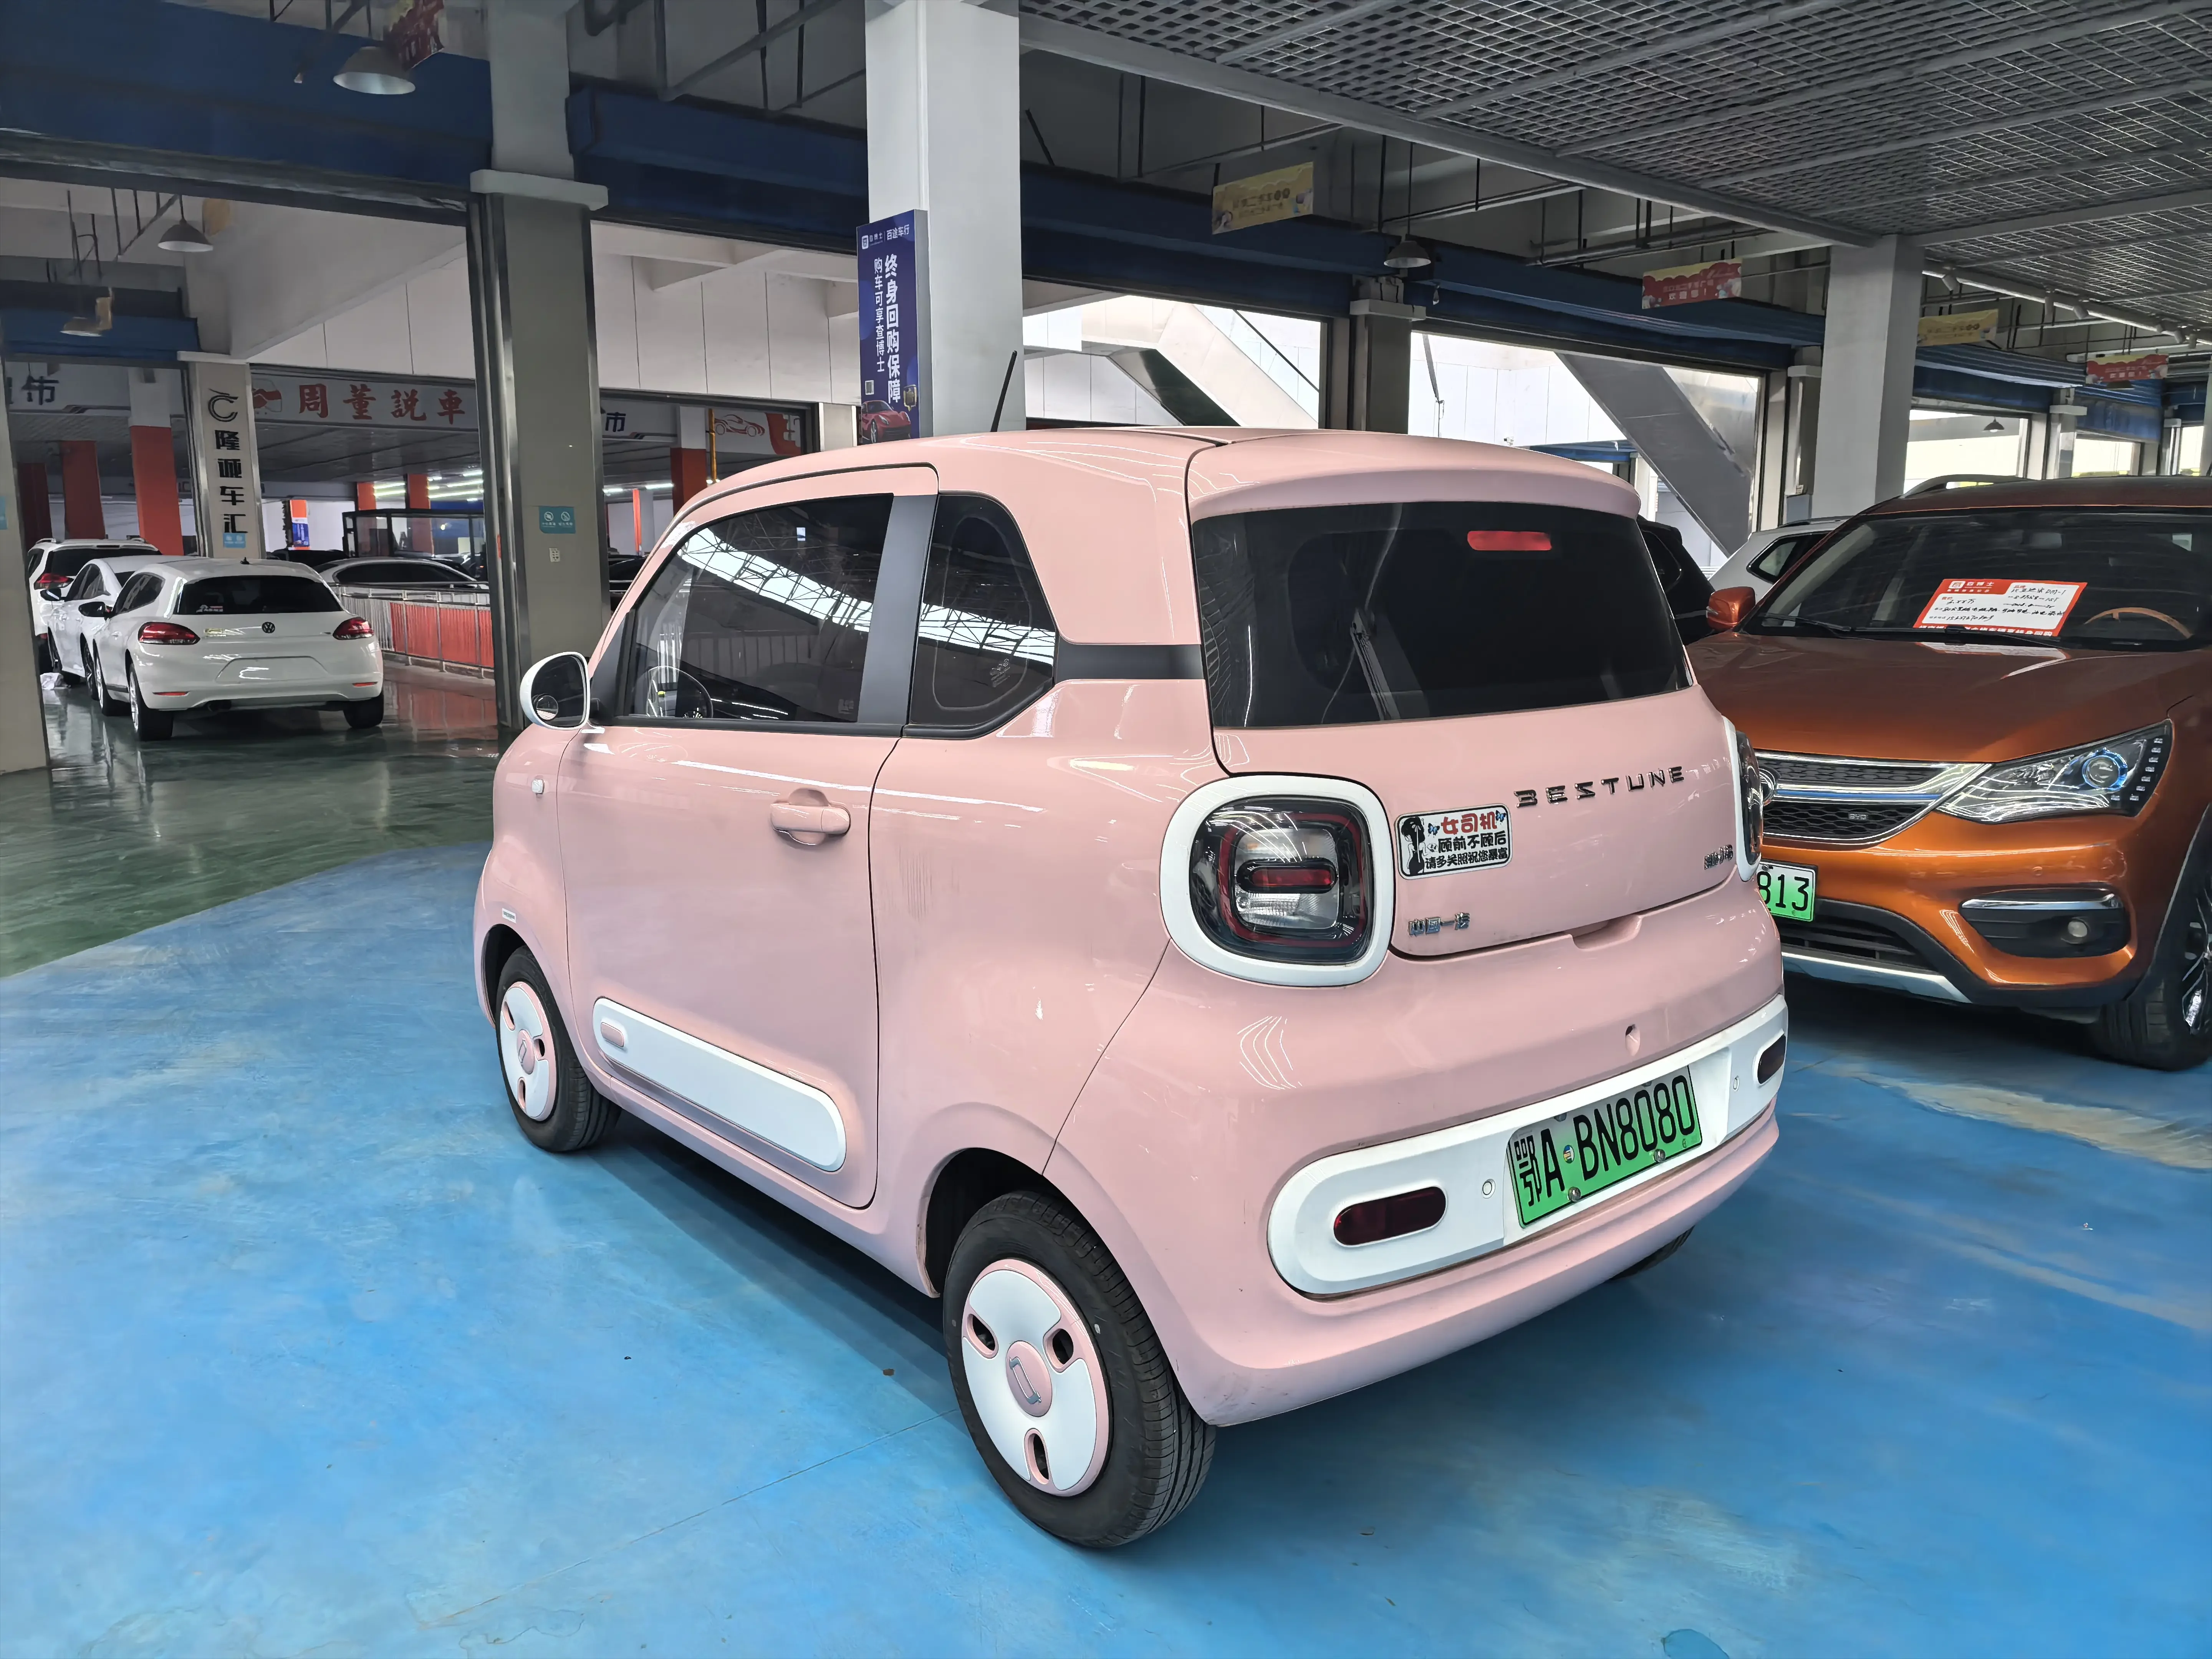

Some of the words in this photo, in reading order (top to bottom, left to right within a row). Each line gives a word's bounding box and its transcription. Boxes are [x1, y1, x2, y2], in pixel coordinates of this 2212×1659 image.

[874, 257, 885, 373] 购车可享查博士
[885, 253, 901, 404] 终身回购保障
[1513, 766, 1684, 808] BESTUNE
[1438, 830, 1507, 853] 顾前不顾后
[1441, 811, 1497, 835] 女司机
[1425, 847, 1508, 869] 请多关照祝您暴富
[1757, 871, 1809, 911] 813
